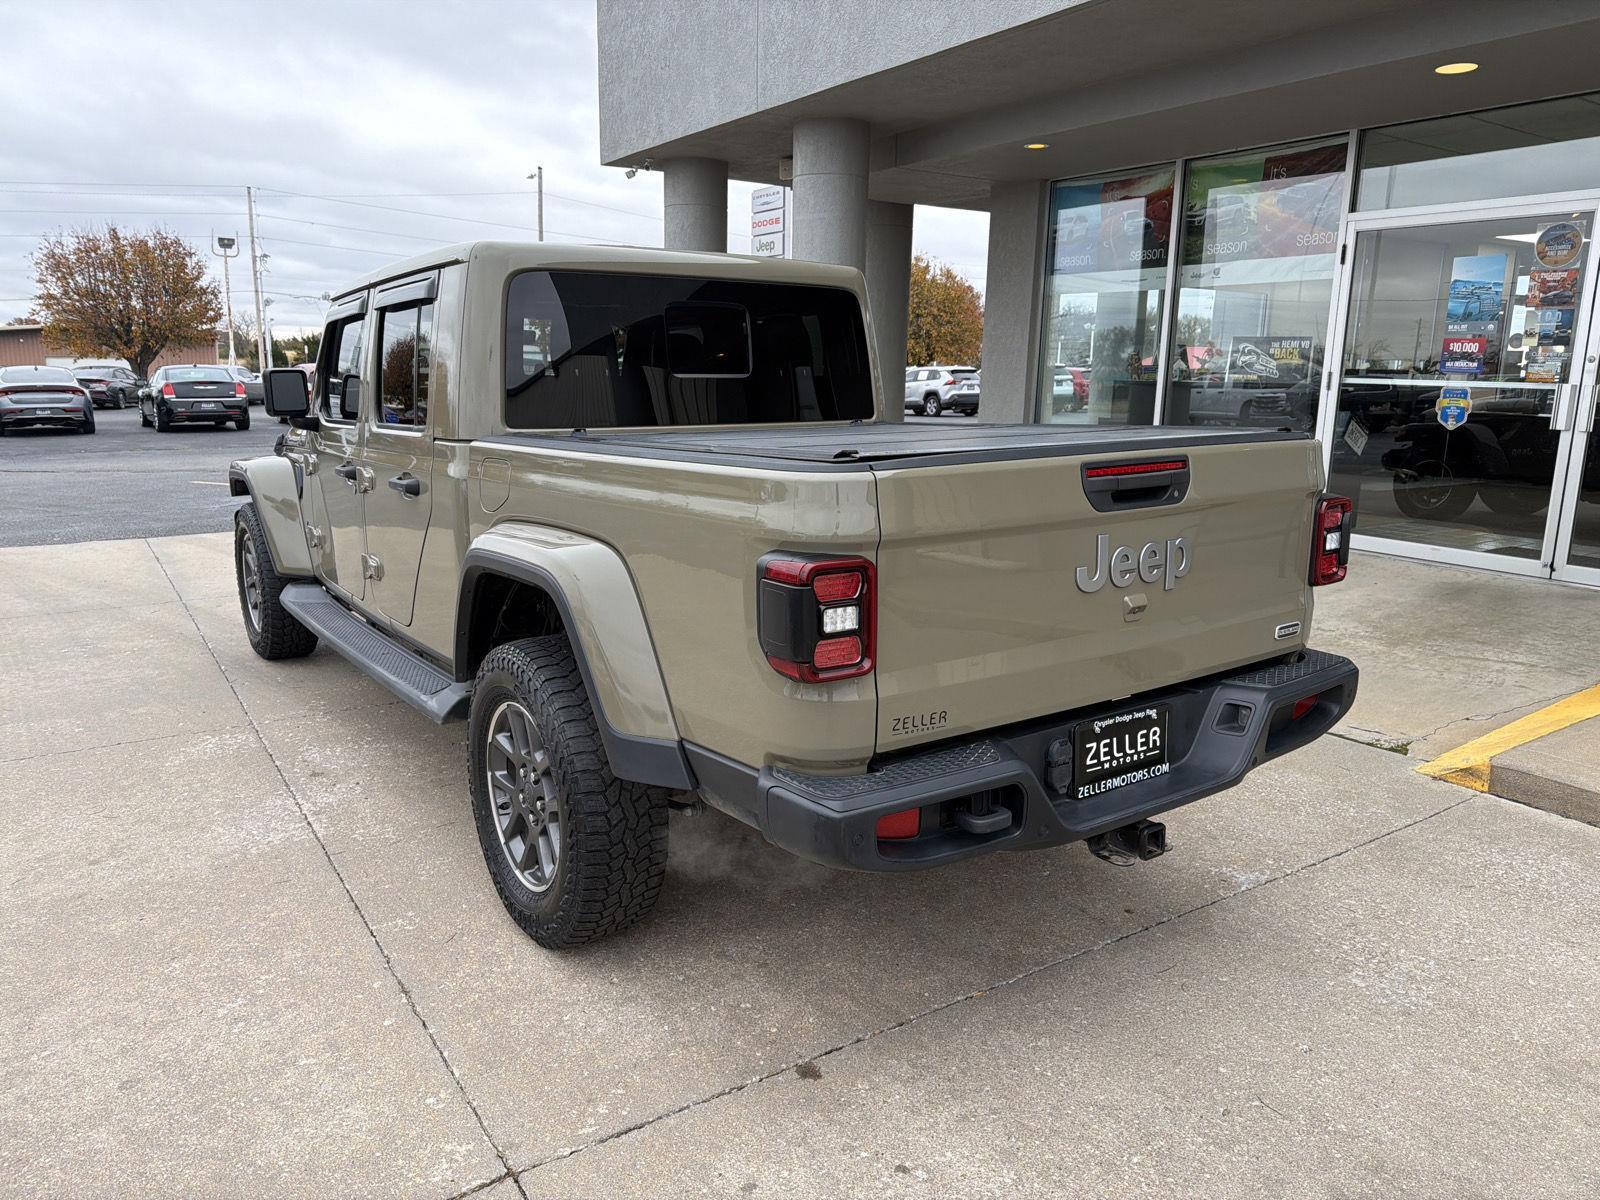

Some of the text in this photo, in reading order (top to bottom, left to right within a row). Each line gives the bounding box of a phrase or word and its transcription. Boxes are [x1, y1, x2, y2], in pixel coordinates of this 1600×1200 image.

[1270, 164, 1287, 180] It's
[752, 190, 781, 200] CHRYSLER
[752, 217, 781, 229] DODGE
[756, 239, 775, 253] Jeep
[1281, 340, 1300, 348] HEMI
[1301, 340, 1310, 349] V8
[1274, 348, 1300, 360] BACK
[1076, 534, 1191, 593] Jeep
[892, 710, 948, 731] ZELLER
[1094, 718, 1115, 728] Chrysler
[1115, 714, 1132, 723] Dodge
[1133, 711, 1145, 719] Jeep
[904, 726, 935, 735] MOTORS
[1086, 726, 1161, 765] ZELLER
[1103, 753, 1145, 769] MOTORS
[1078, 762, 1170, 799] ZELLERMOTORS.COM
